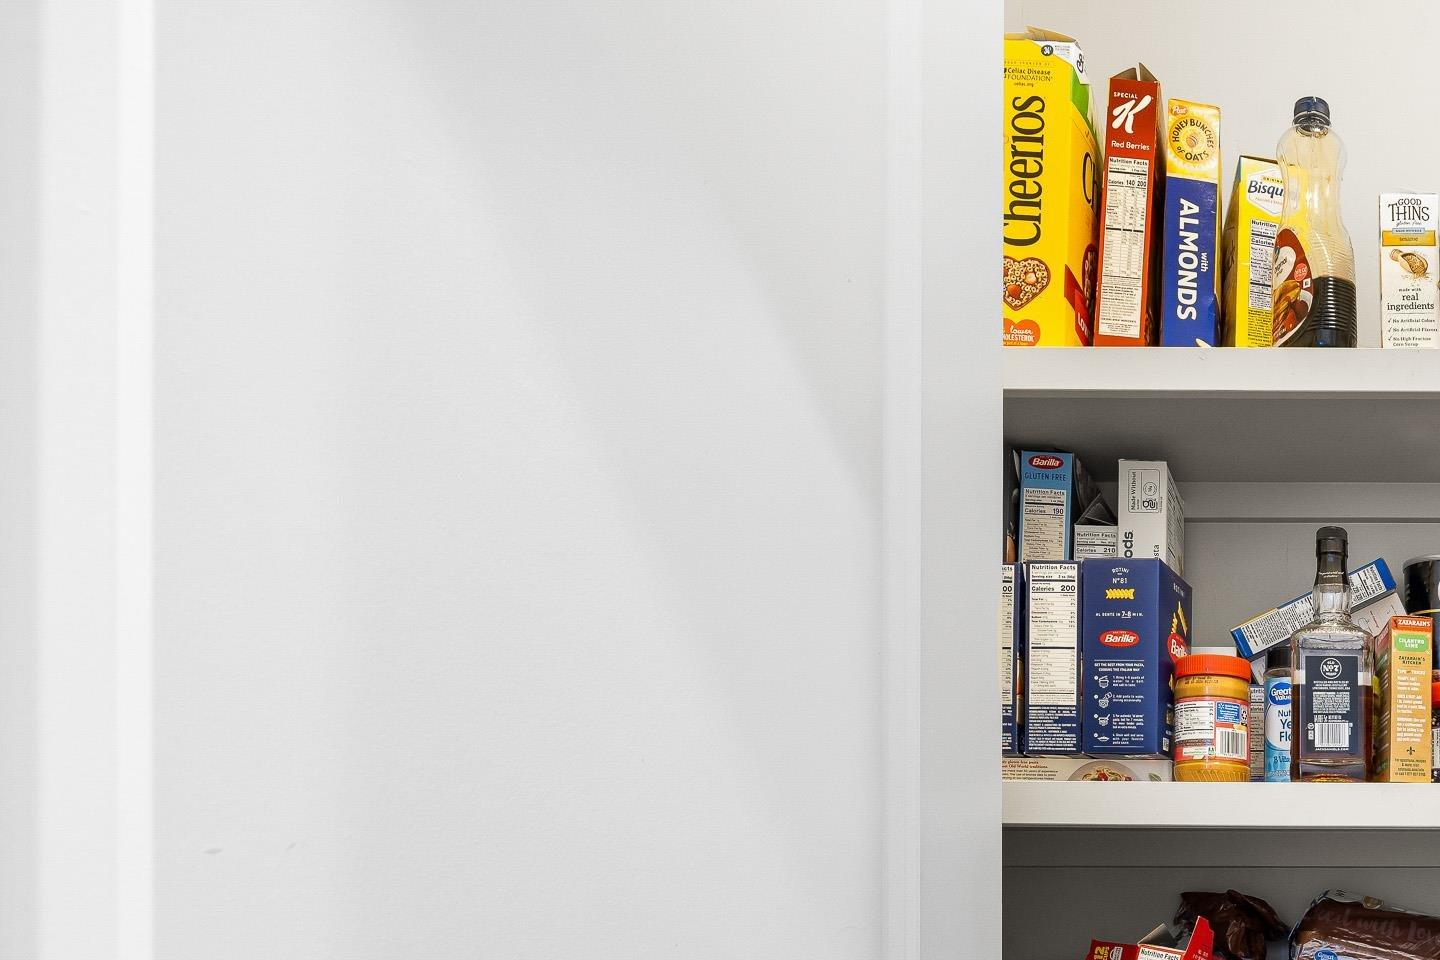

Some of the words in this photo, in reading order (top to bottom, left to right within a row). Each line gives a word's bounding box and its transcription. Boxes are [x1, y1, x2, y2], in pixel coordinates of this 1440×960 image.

[1113, 91, 1138, 100] SPECIAL
[1112, 95, 1152, 133] K
[1190, 118, 1214, 149] BUNCHES
[1111, 140, 1124, 149] Red
[1126, 142, 1150, 151] Berries
[1185, 150, 1210, 162] OATS
[1109, 157, 1133, 166] Nutrition
[1004, 95, 1045, 246] Cheerios
[1248, 180, 1284, 199] Bisqu
[1397, 198, 1422, 206] GOOD
[1388, 203, 1430, 221] THINS
[1251, 219, 1277, 228] Nutrition
[1176, 197, 1200, 321] ALMONDS
[1199, 251, 1209, 273] with
[1402, 293, 1419, 301] real
[1387, 302, 1435, 312] ingredients
[1032, 457, 1060, 467] Barilla
[1024, 472, 1049, 480] GLUTEN
[1052, 473, 1067, 481] FREE
[1124, 531, 1134, 558] ods
[1398, 619, 1431, 627] ZATARAIN'S
[1104, 634, 1137, 643] Barilla
[1398, 637, 1425, 645] CILANTRO
[1271, 688, 1292, 696] Great
[1140, 949, 1164, 960] Nutrition
[1317, 951, 1335, 960] Great
